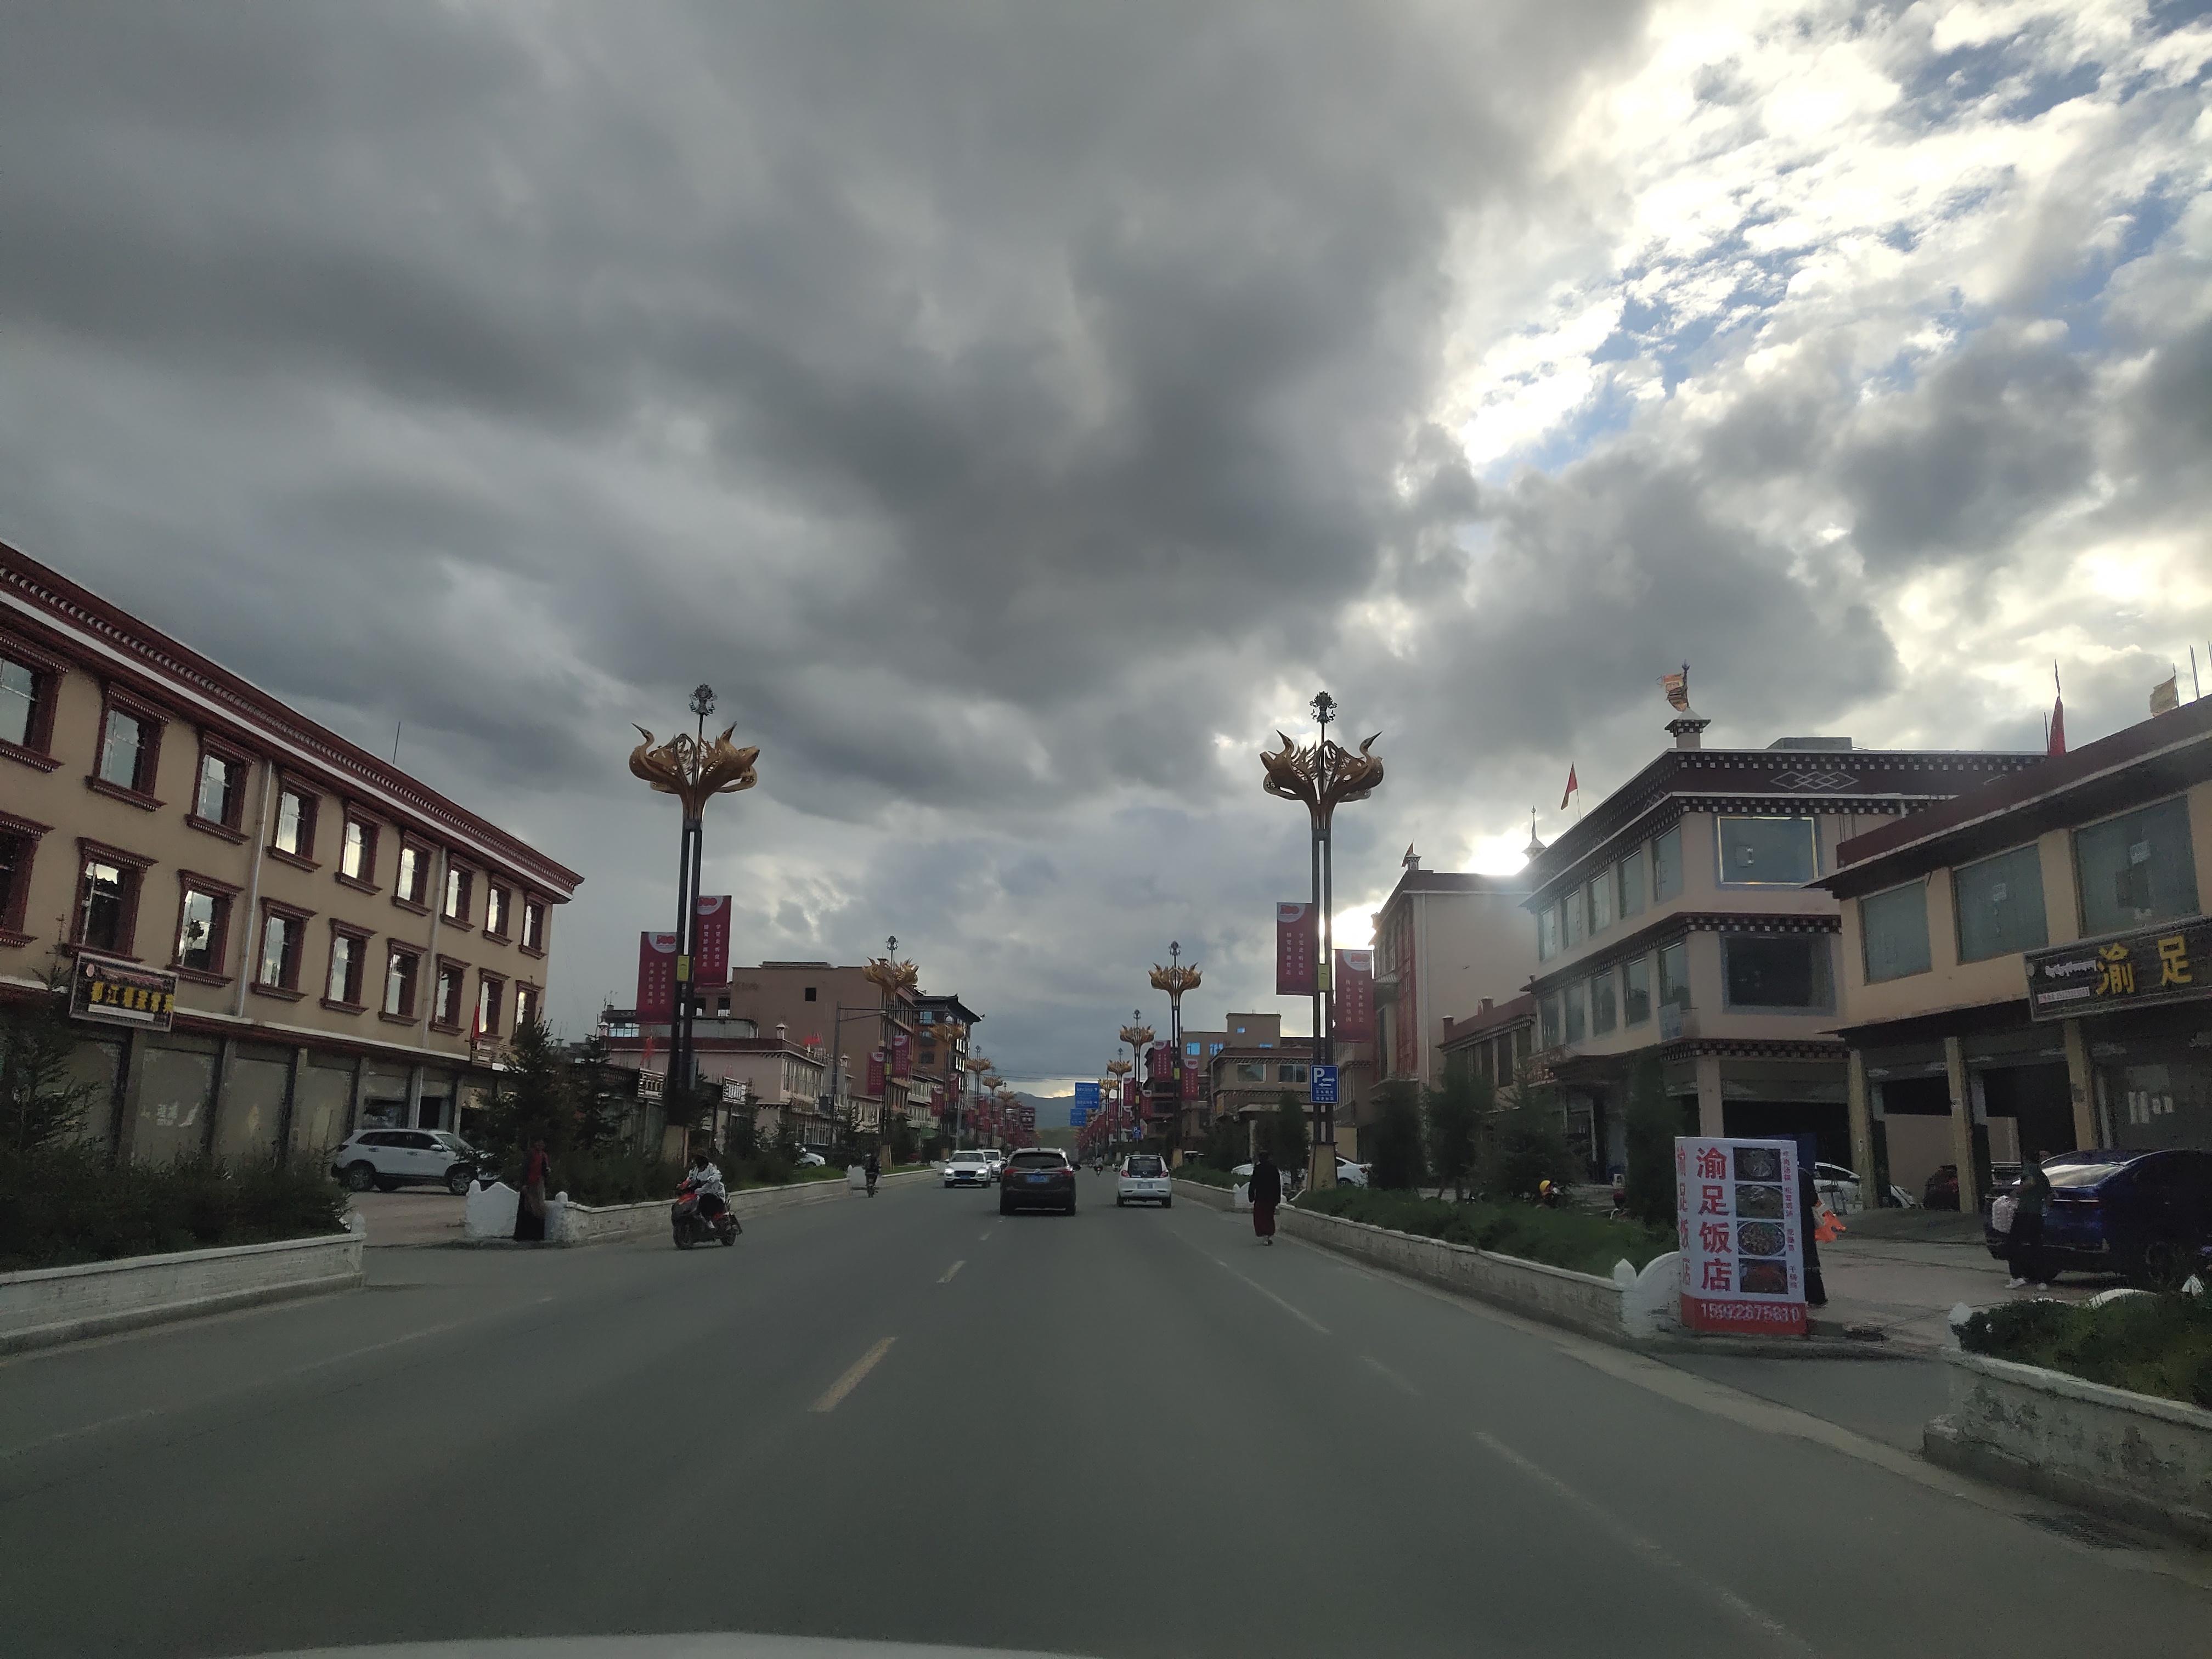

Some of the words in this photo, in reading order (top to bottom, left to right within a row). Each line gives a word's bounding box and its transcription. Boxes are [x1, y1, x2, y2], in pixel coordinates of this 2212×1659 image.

[2096, 934, 2192, 995] 渝足
[1314, 1068, 1325, 1083] P
[1696, 1147, 1733, 1291] 渝足饭店
